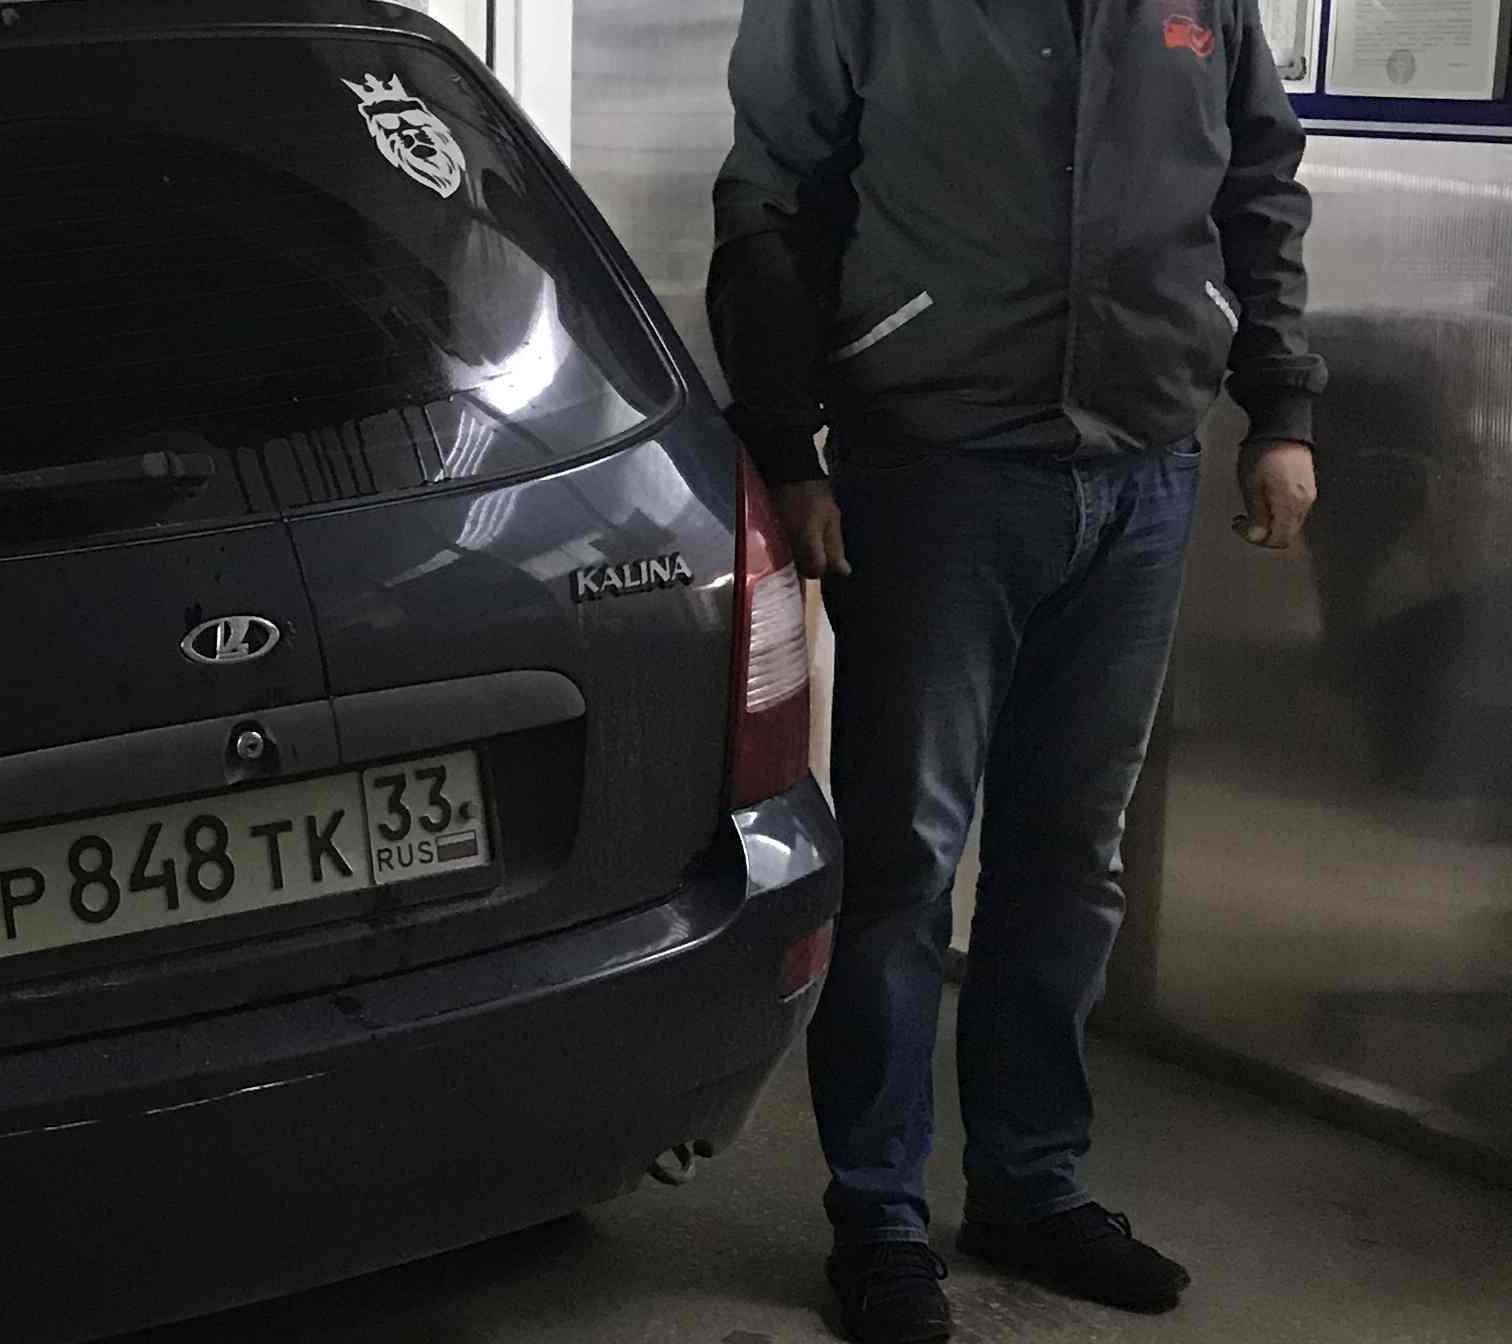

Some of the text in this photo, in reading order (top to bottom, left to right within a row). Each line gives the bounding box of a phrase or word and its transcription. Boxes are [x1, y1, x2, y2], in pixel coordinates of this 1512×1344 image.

[575, 555, 693, 596] KALINA
[372, 765, 453, 842] 33
[375, 842, 436, 872] RUS
